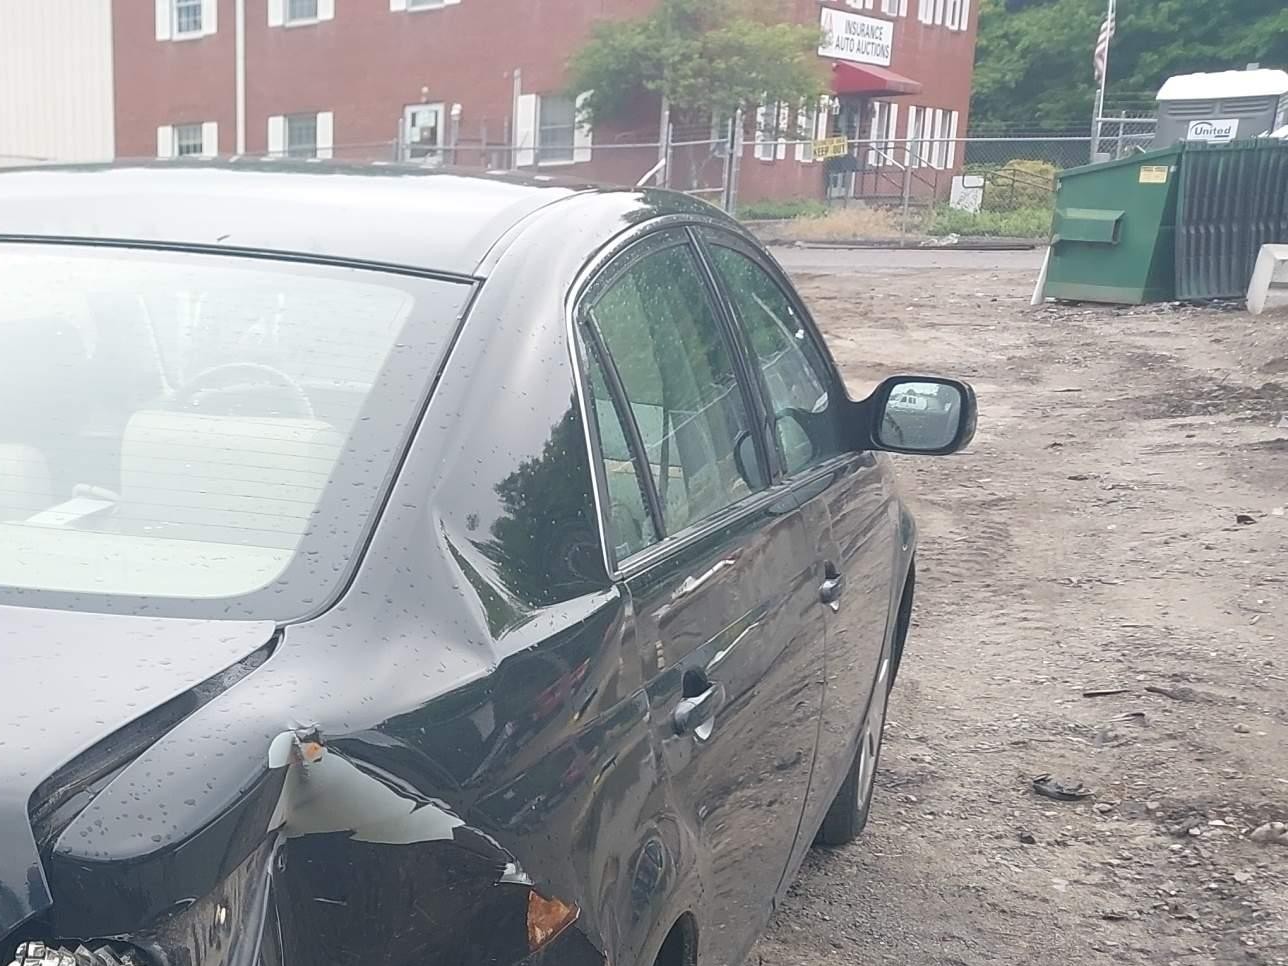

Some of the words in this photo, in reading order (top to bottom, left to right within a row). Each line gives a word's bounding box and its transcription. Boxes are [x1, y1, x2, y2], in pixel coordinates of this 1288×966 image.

[844, 19, 884, 41] INSURANCE
[835, 35, 855, 53] AUTO
[856, 39, 890, 59] AUCTIONS
[1194, 126, 1232, 136] United
